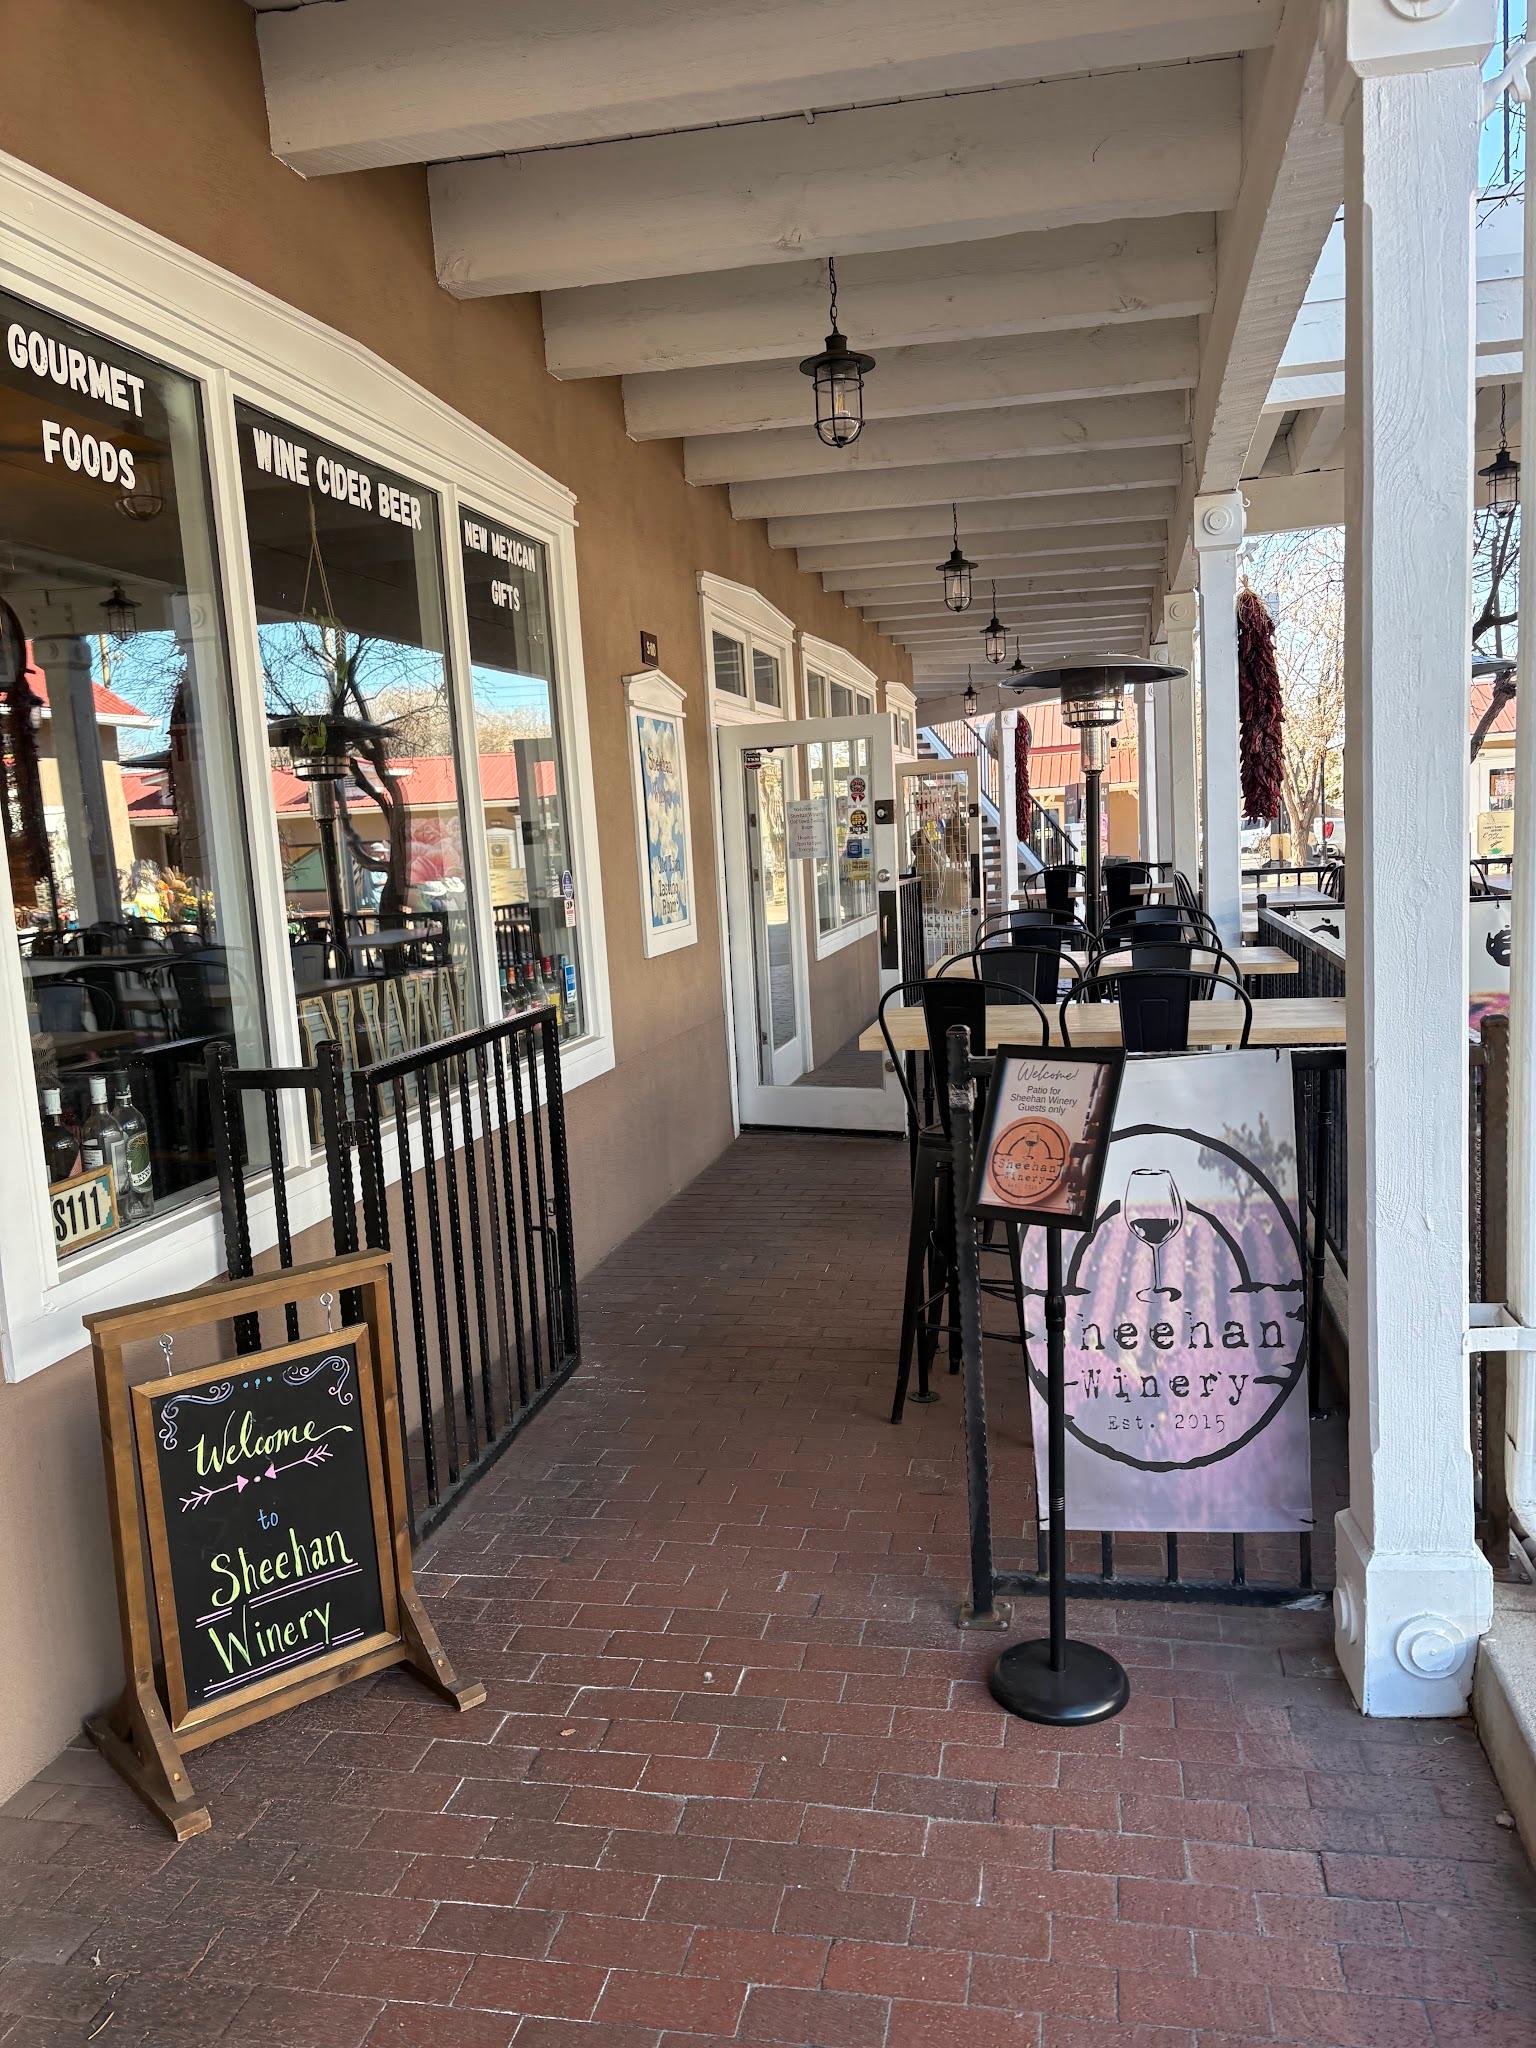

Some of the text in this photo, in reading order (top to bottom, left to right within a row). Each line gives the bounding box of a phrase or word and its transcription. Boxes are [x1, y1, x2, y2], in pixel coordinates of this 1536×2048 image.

[7, 323, 145, 418] GOURMET
[42, 419, 136, 490] FOODS
[253, 427, 422, 531] WINE CIDER BEER
[464, 519, 536, 573] NEW MEXICAN
[491, 578, 521, 612] GIFTS
[1017, 1061, 1079, 1082] Welcome!
[1027, 1085, 1062, 1096] Patio for
[1010, 1093, 1078, 1107] Sheehan Winery
[1018, 1103, 1066, 1115] Guests only
[998, 1158, 1057, 1173] Sheehan
[1004, 1173, 1047, 1185] Winery
[54, 1185, 101, 1241] S111
[1077, 1312, 1286, 1351] heehan
[1081, 1366, 1250, 1406] Winery
[188, 1410, 354, 1476] Welcome
[1107, 1414, 1226, 1433] Est. 2015
[258, 1508, 280, 1531] to
[211, 1528, 354, 1607] Sheehan
[208, 1602, 331, 1673] Winery
